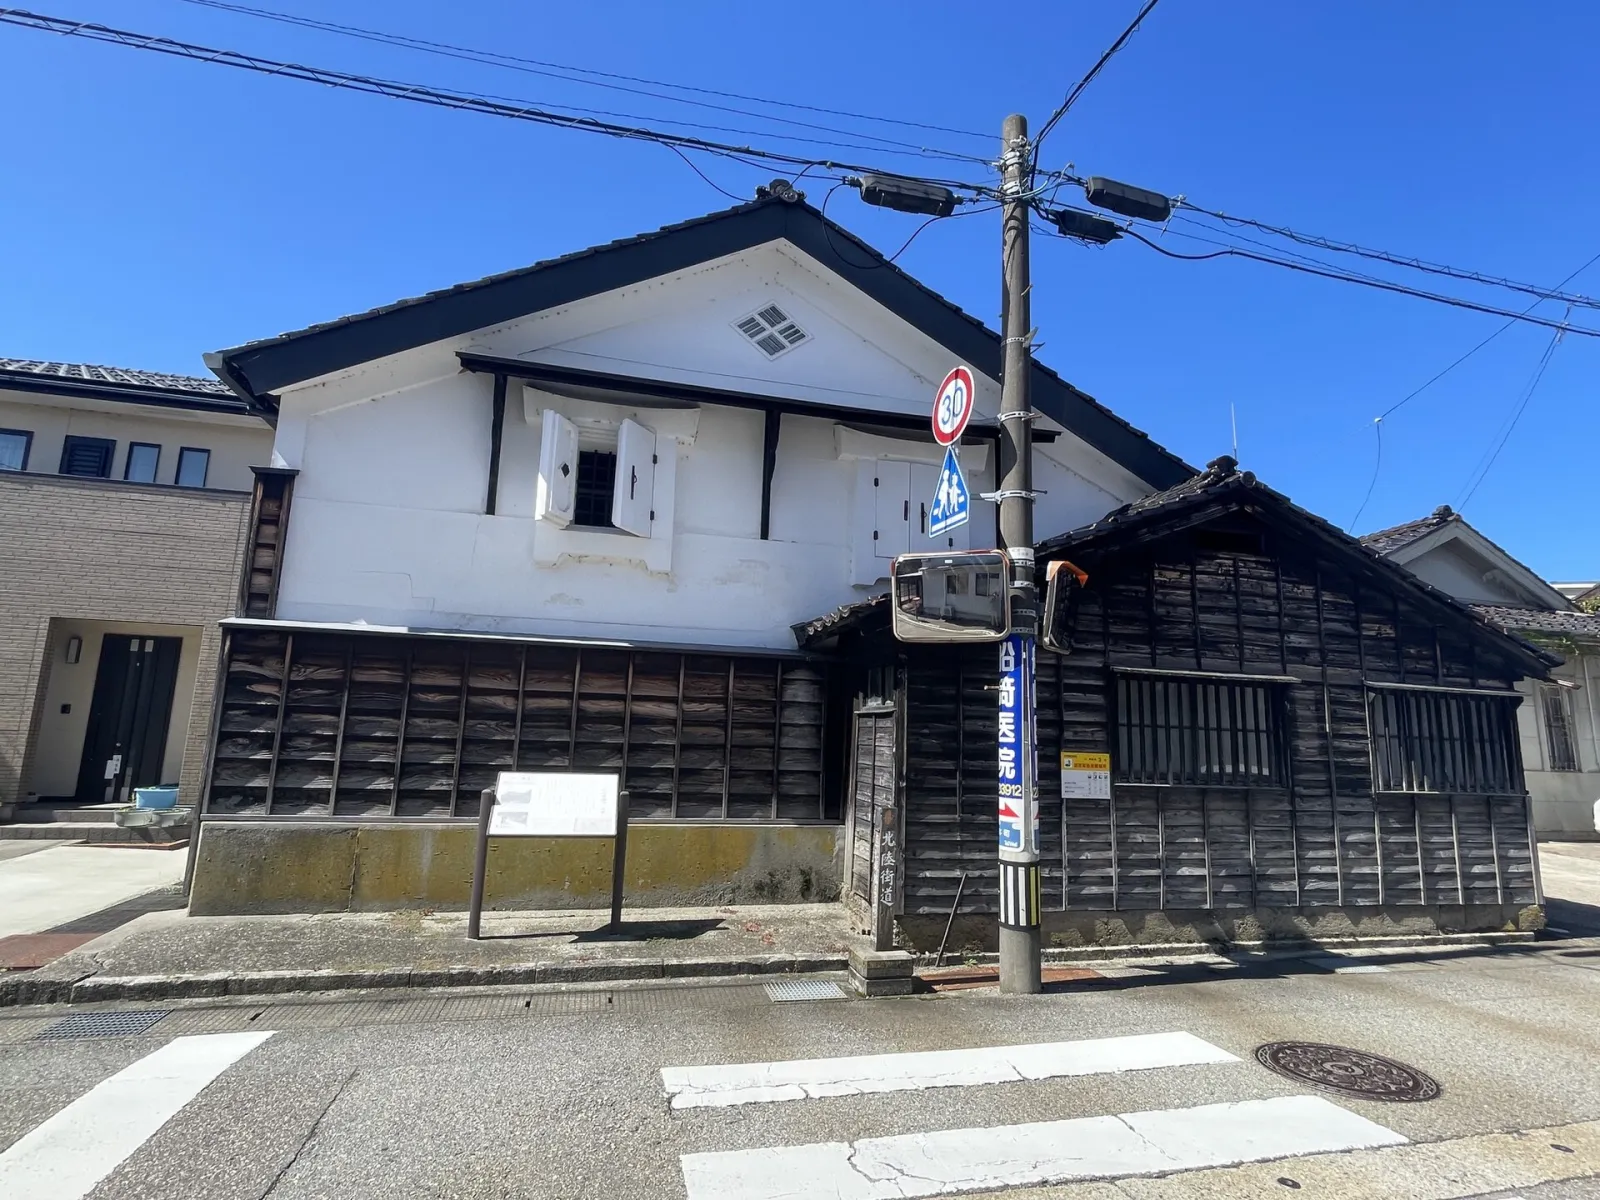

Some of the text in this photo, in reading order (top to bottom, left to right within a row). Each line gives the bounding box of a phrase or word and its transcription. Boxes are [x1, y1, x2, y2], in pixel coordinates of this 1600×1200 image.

[941, 386, 964, 426] 30
[880, 831, 896, 907] 北陸街道
